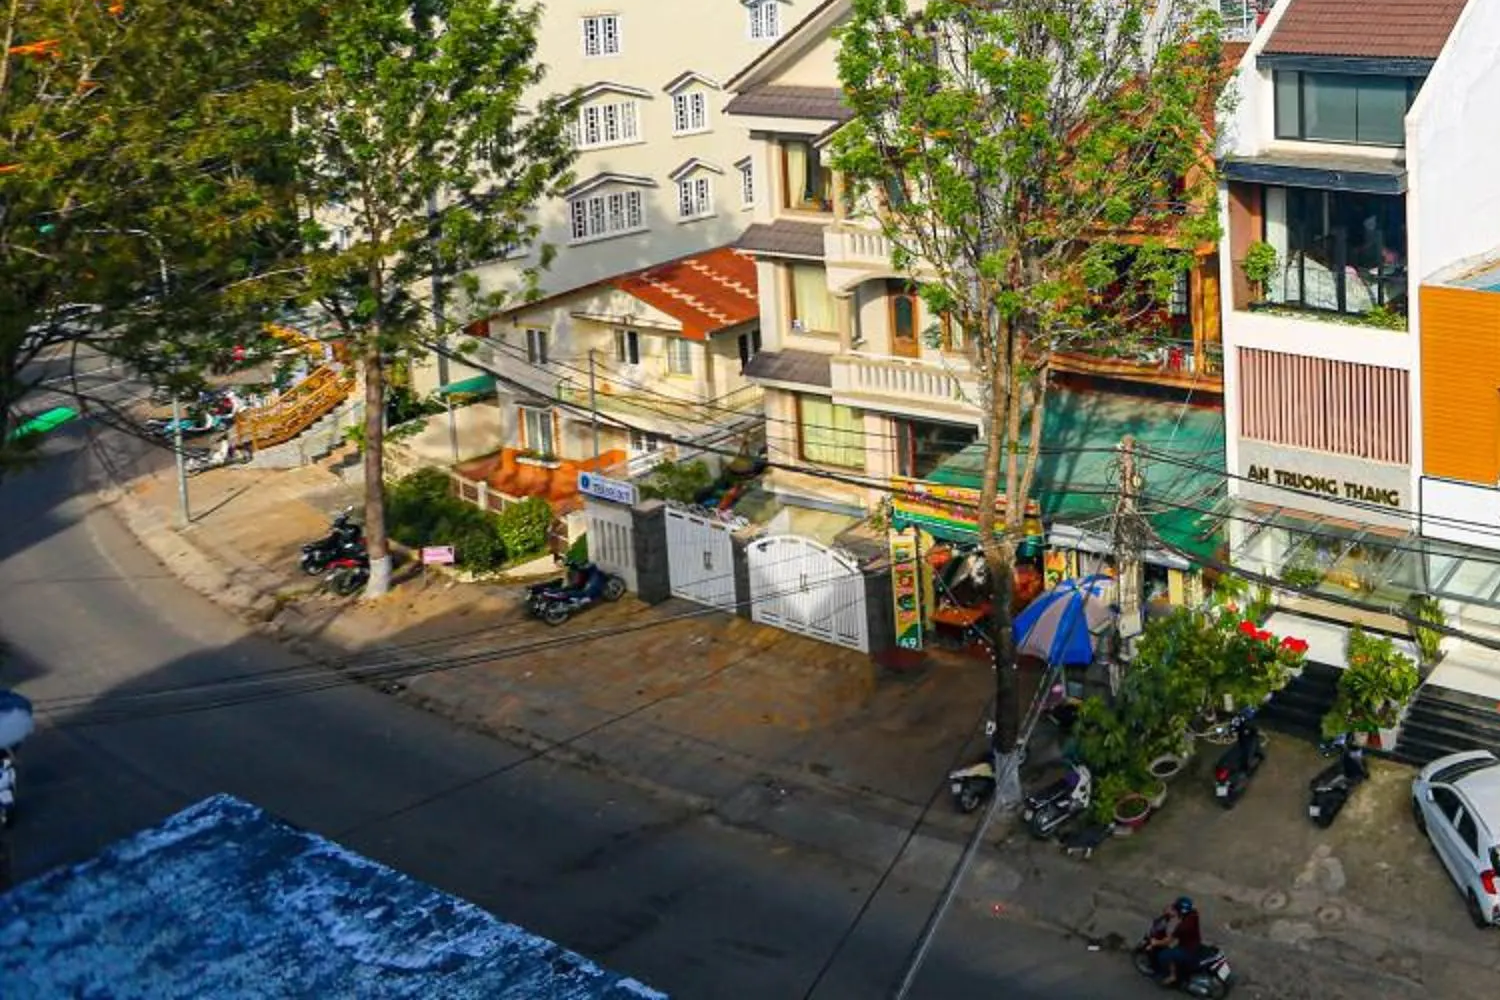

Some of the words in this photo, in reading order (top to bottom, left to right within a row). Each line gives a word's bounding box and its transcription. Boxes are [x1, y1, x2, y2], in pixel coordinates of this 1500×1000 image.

[1248, 464, 1269, 482] AN
[1274, 470, 1338, 495] TRUONG
[1344, 483, 1400, 507] THANG
